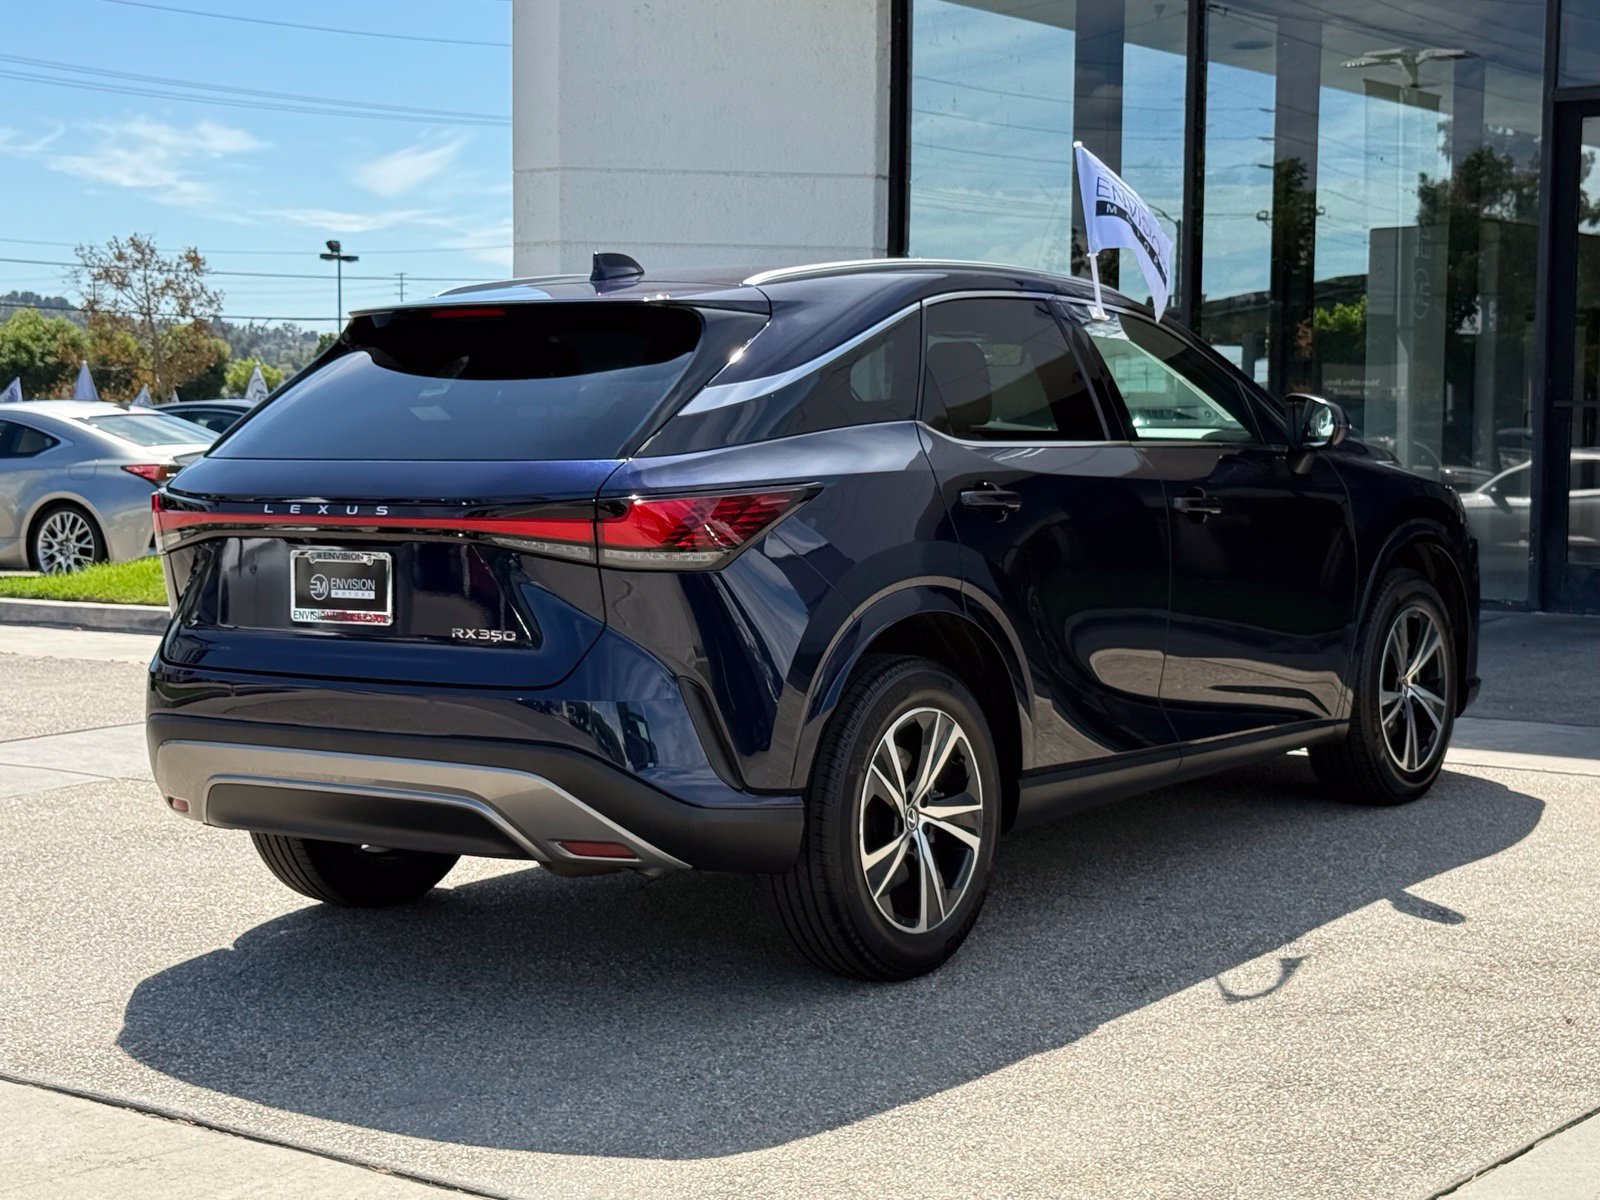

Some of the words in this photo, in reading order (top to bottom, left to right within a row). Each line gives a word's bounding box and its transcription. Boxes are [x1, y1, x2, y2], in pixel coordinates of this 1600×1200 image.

[1096, 176, 1168, 275] ENVISO
[263, 504, 389, 515] LEXUS
[323, 552, 364, 561] ENVISION
[330, 578, 375, 590] ENVISION
[293, 610, 330, 621] ENVISIO
[451, 628, 517, 641] RX350
